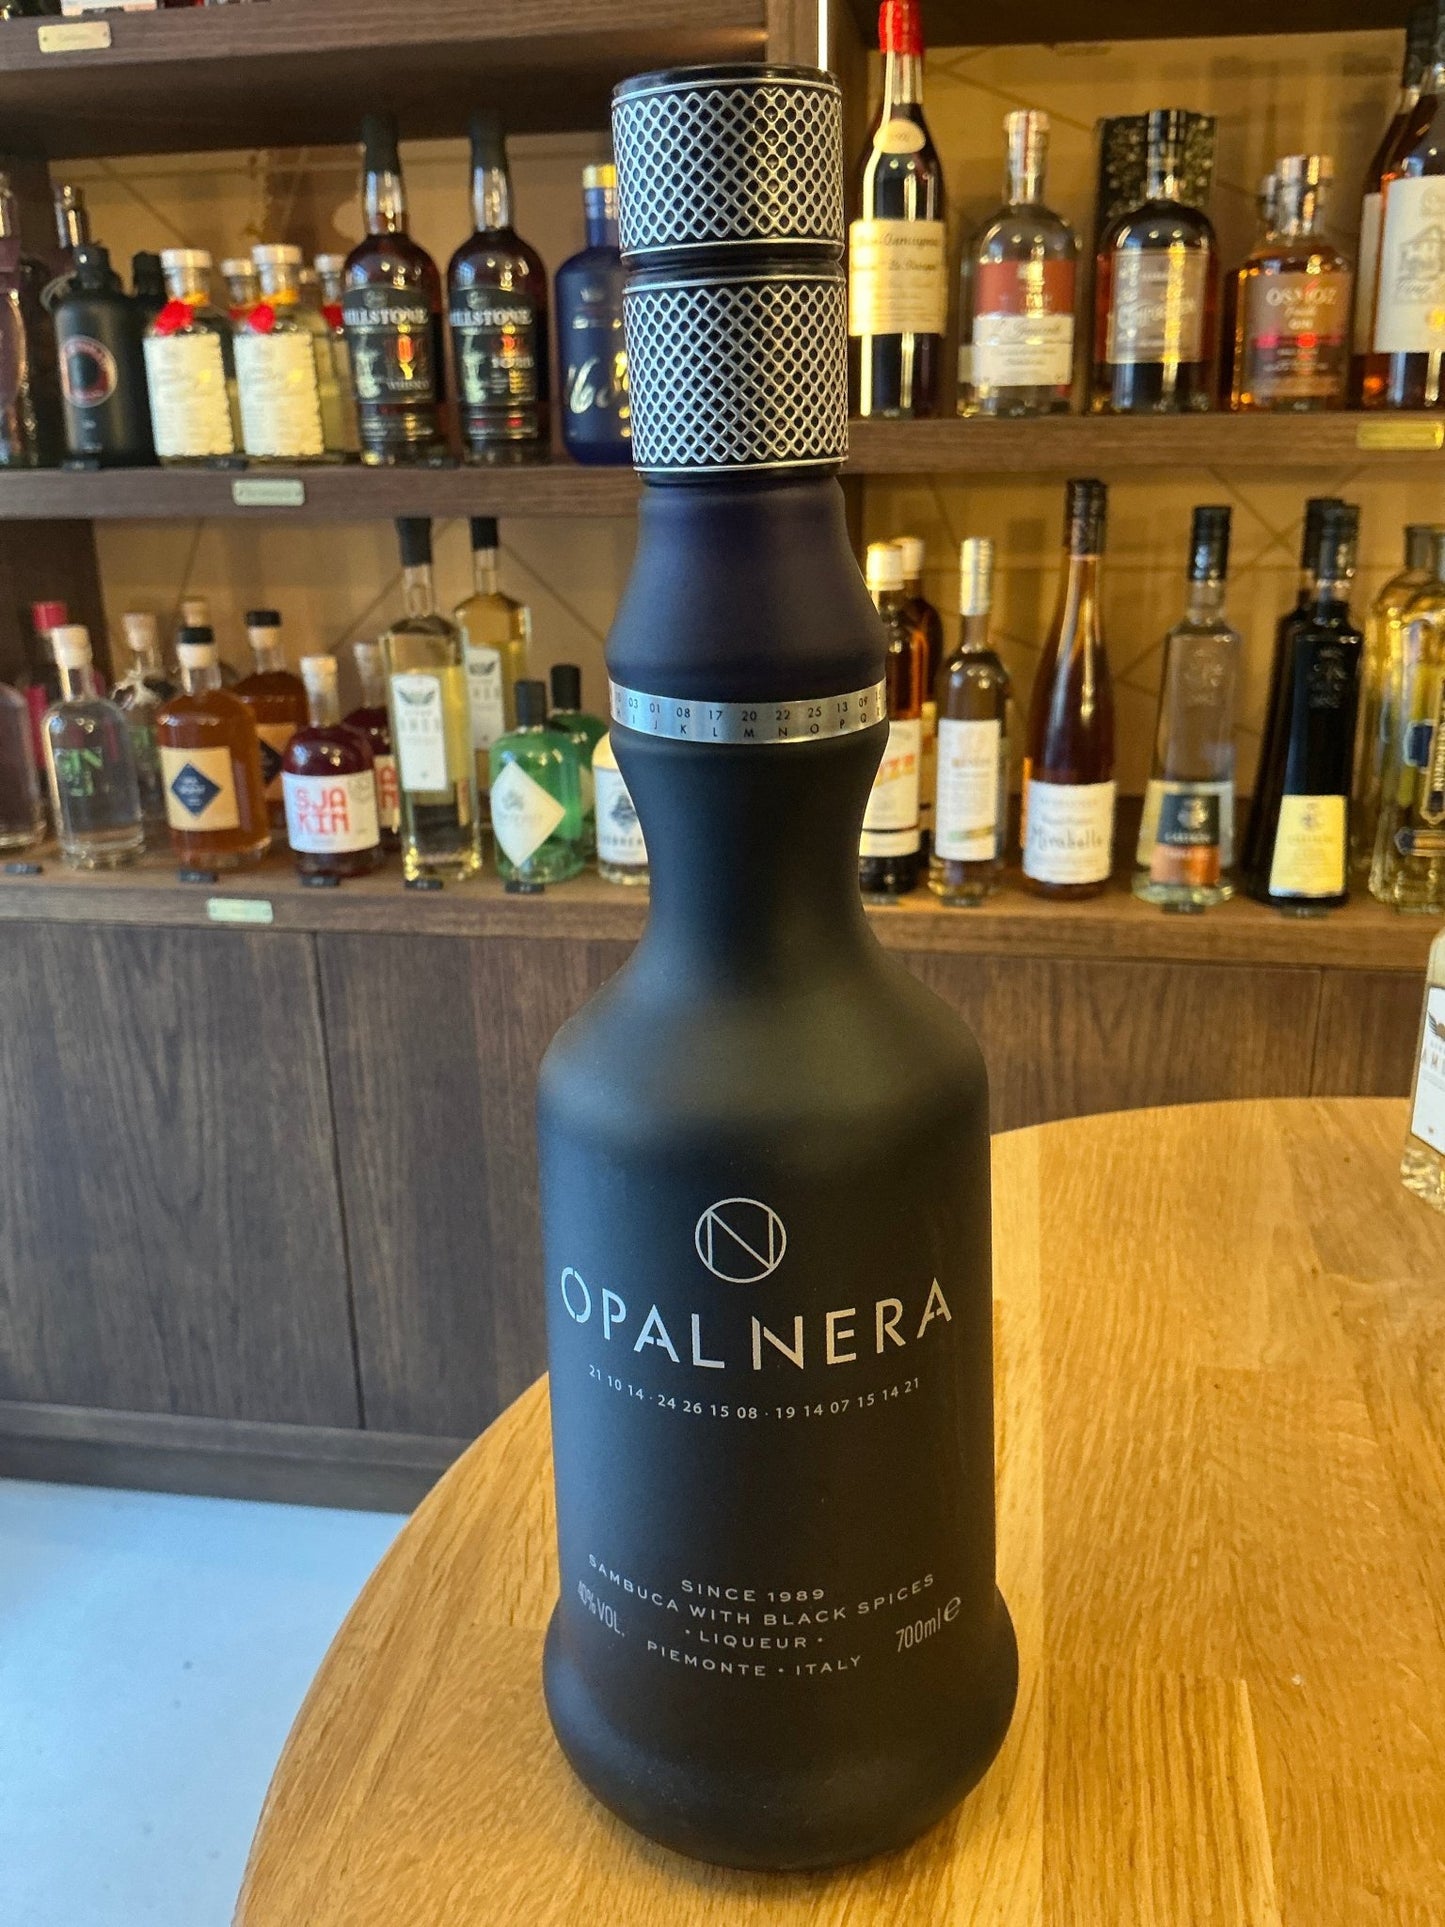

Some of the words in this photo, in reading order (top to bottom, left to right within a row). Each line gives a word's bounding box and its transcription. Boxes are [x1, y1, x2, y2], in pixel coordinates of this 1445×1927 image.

[628, 697, 639, 709] 03
[649, 702, 661, 714] 01
[676, 706, 691, 719] 08
[708, 709, 724, 721] 17
[741, 710, 758, 722] 20
[775, 709, 791, 721] 22
[807, 706, 822, 719] 25
[837, 701, 849, 713] 13
[858, 696, 869, 708] 09
[680, 724, 687, 735] K
[713, 727, 718, 737] L
[743, 728, 755, 739] M
[778, 727, 788, 737] N
[809, 723, 820, 734] O
[839, 719, 846, 729] P
[860, 712, 868, 724] Q
[560, 1266, 726, 1369] OPAL
[751, 1276, 953, 1371] NERA
[588, 1363, 602, 1381] 21
[607, 1375, 623, 1392] 10
[628, 1384, 645, 1401] 14
[657, 1393, 676, 1410] 24
[682, 1399, 703, 1415] 26
[709, 1403, 730, 1418] 15
[736, 1406, 758, 1420] 08
[775, 1405, 796, 1420] 19
[803, 1403, 824, 1418] 14
[829, 1398, 850, 1415] 07
[857, 1392, 876, 1409] 15
[881, 1385, 900, 1402] 14
[904, 1376, 920, 1394] 21
[588, 1553, 681, 1613] SAMBUCA
[688, 1603, 751, 1626] WITH
[763, 1606, 847, 1627] BLACK
[857, 1573, 935, 1616] SPICES
[680, 1578, 758, 1603] SINCE
[767, 1588, 825, 1603] 1989
[699, 1629, 807, 1651] LIQUEUR
[647, 1639, 767, 1677] PIEMONTE
[796, 1654, 861, 1677] ITALY
